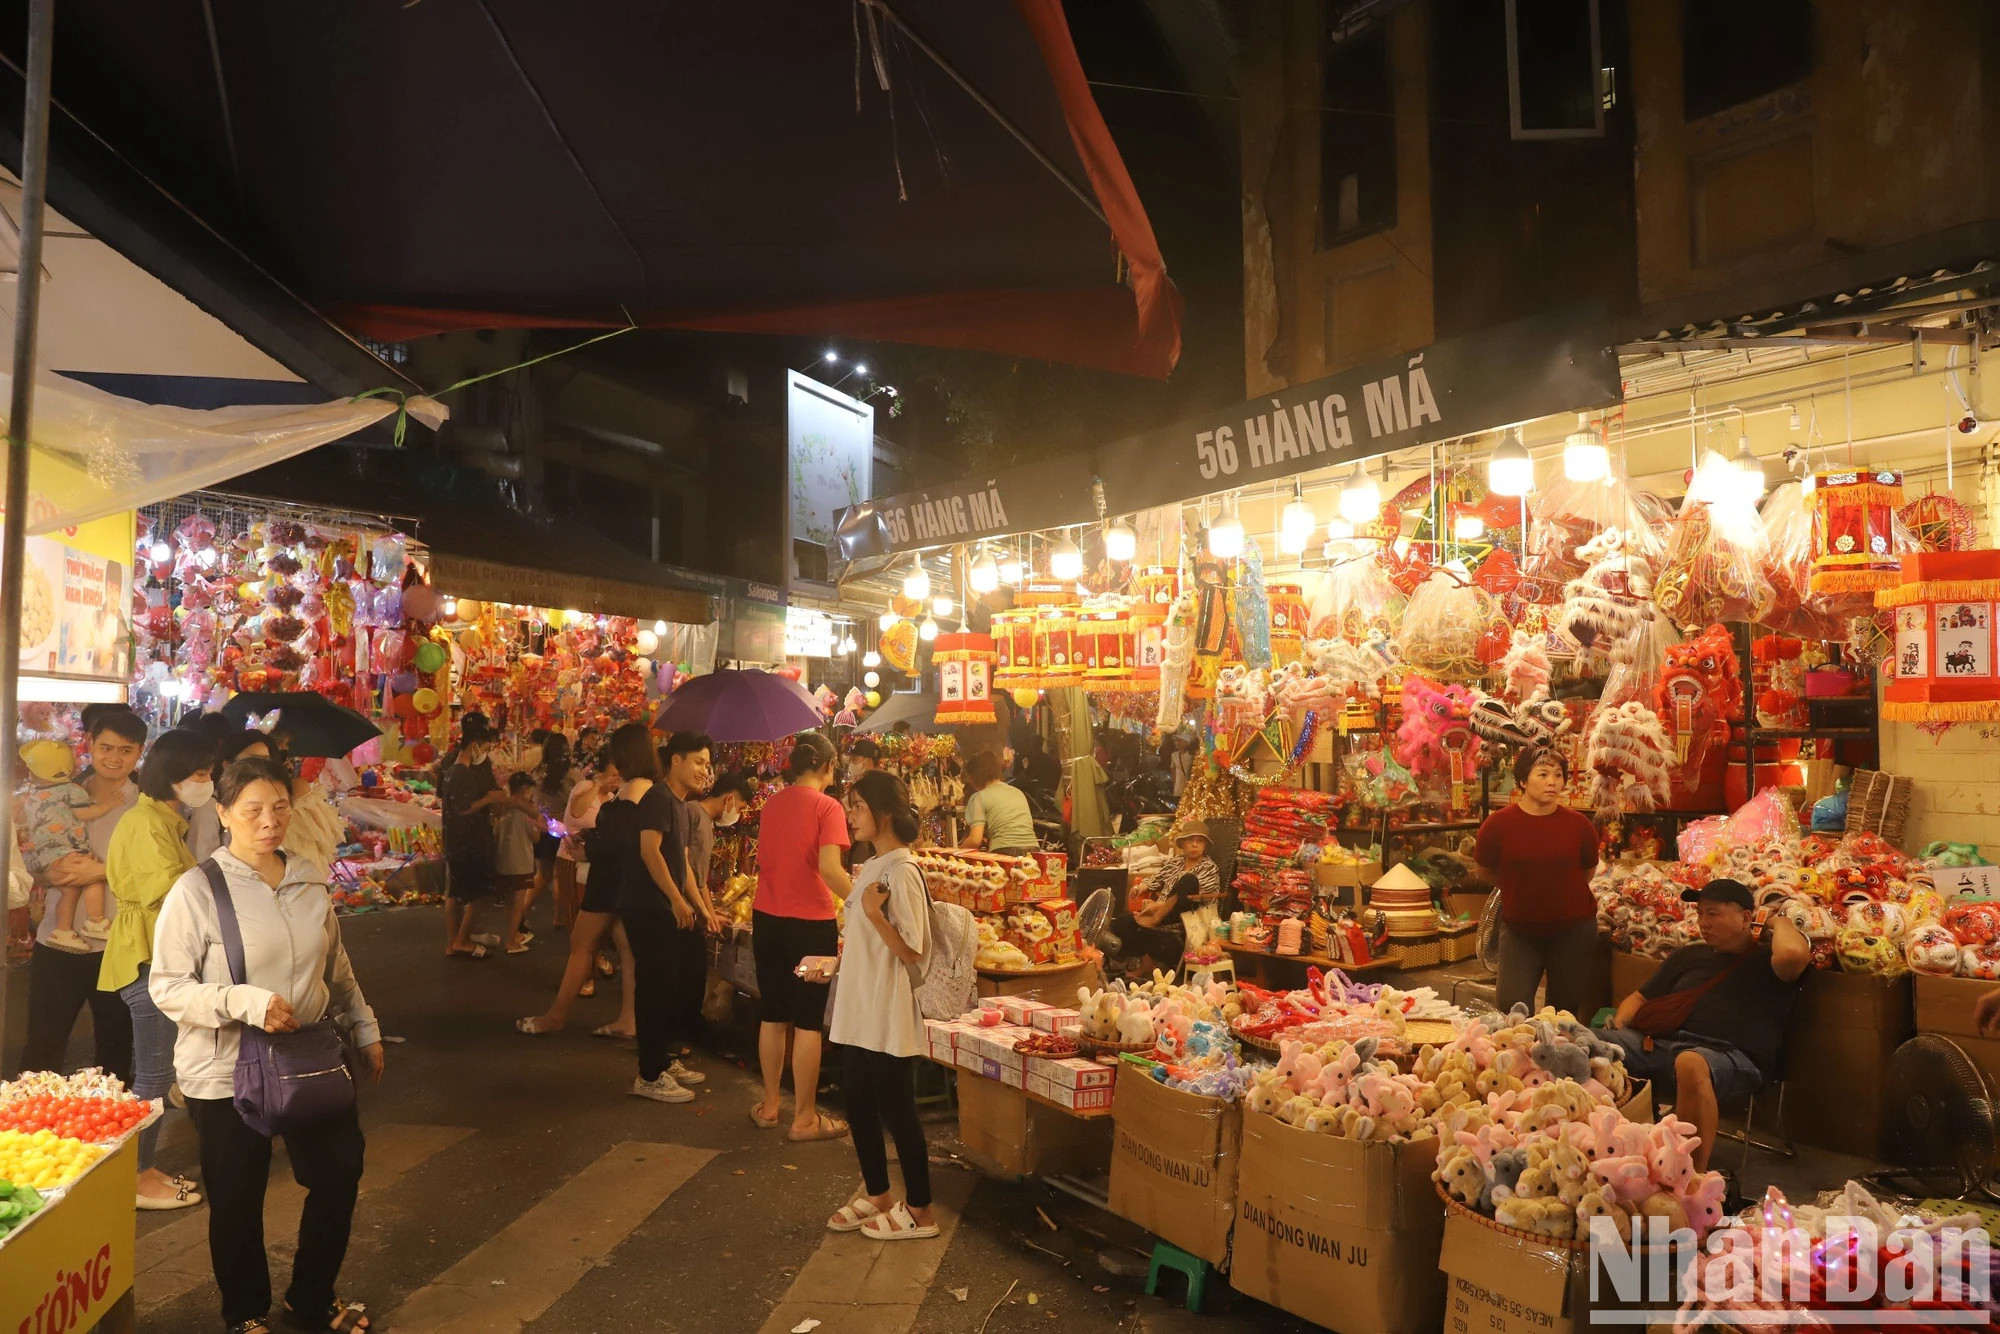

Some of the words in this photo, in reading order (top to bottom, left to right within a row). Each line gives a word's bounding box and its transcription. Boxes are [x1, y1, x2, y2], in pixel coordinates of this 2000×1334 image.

[1195, 425, 1239, 480] 56
[1244, 393, 1353, 469] HÀNG
[1362, 352, 1442, 439] MÃ
[884, 508, 910, 544] 56
[911, 493, 969, 540] HÀNG
[968, 479, 1009, 532] MÃ
[747, 583, 778, 602] Salonpas
[1121, 1131, 1138, 1158] DIAN
[1138, 1143, 1161, 1173] DONG
[1163, 1158, 1190, 1183] WAN
[1193, 1168, 1210, 1188] JU
[1243, 1201, 1266, 1231] DIAN
[1268, 1216, 1305, 1248] DONG
[1307, 1232, 1341, 1261] WAN
[1347, 1245, 1368, 1267] JU
